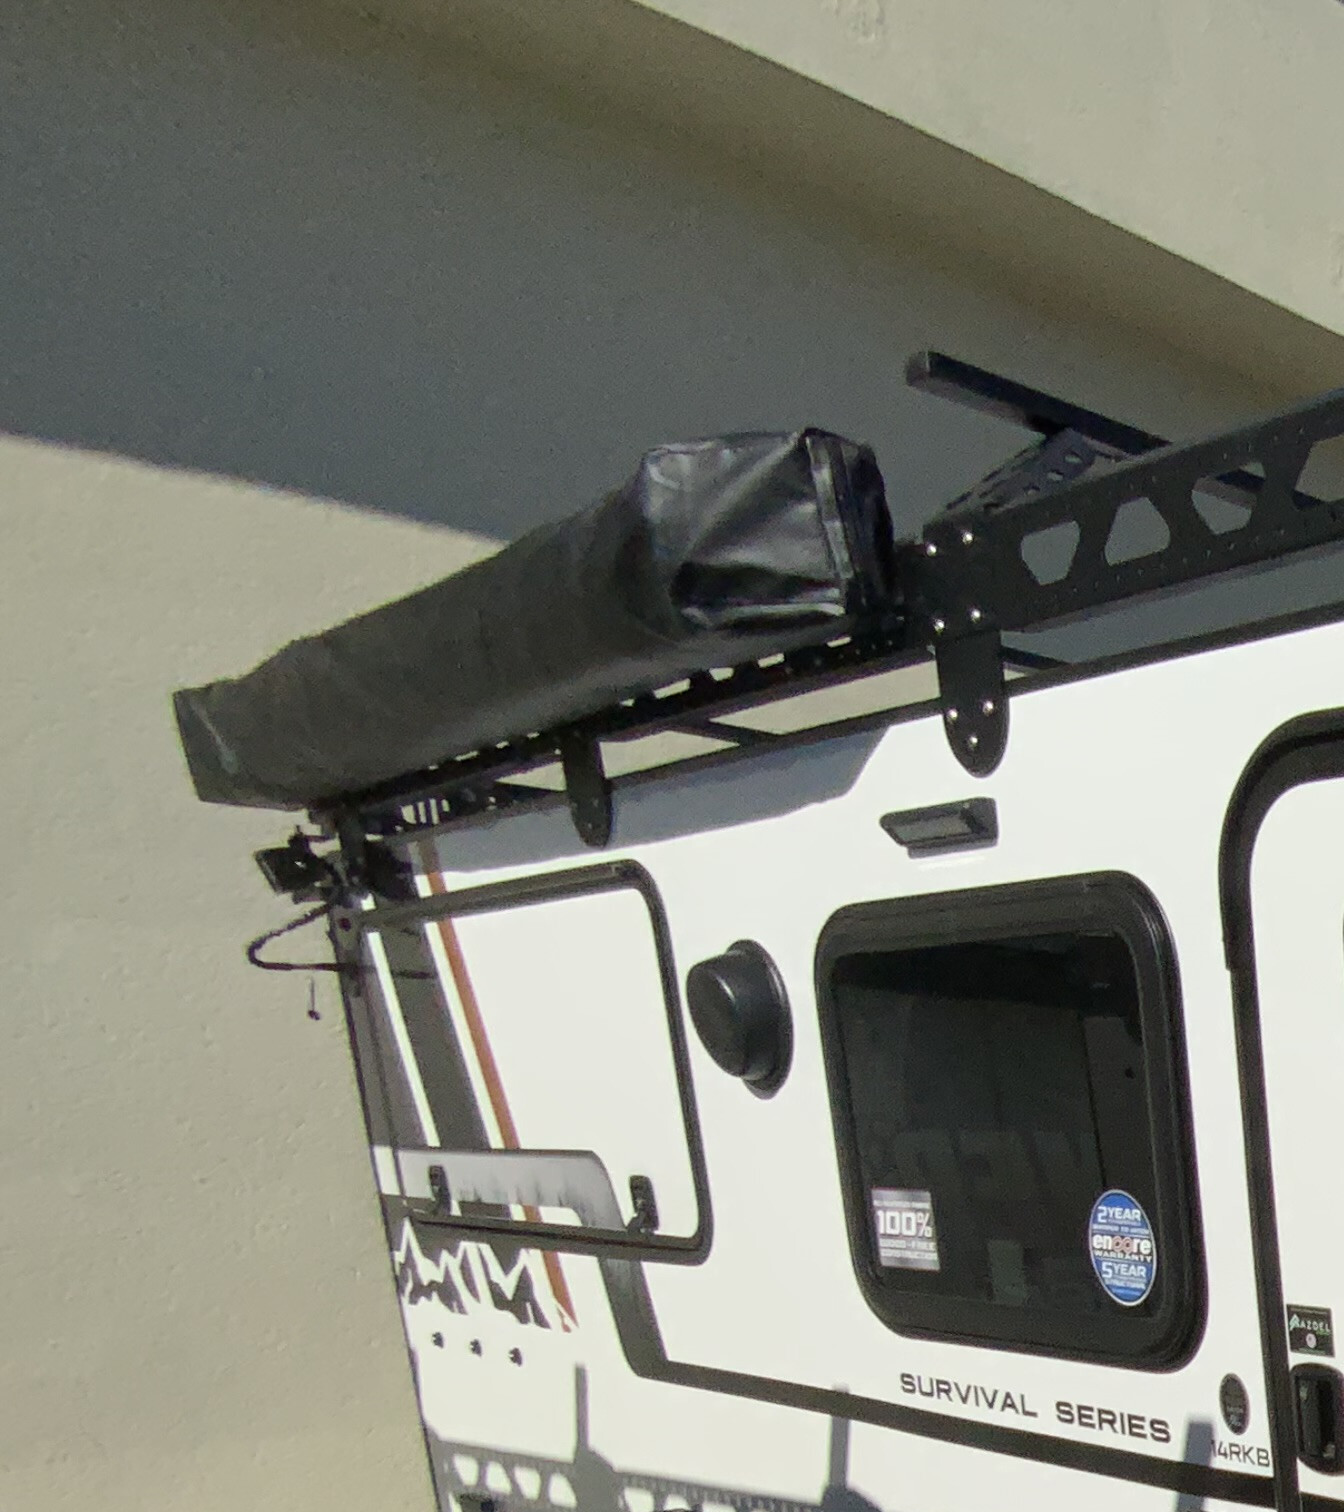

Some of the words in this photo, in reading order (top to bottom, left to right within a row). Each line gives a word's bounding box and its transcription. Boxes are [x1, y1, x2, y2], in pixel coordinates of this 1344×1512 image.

[877, 1210, 932, 1237] 100%
[1107, 1207, 1141, 1221] YEAR
[1113, 1264, 1147, 1278] YEAR
[900, 1372, 1038, 1418] SURVIVAL
[1055, 1400, 1171, 1443] SERIES
